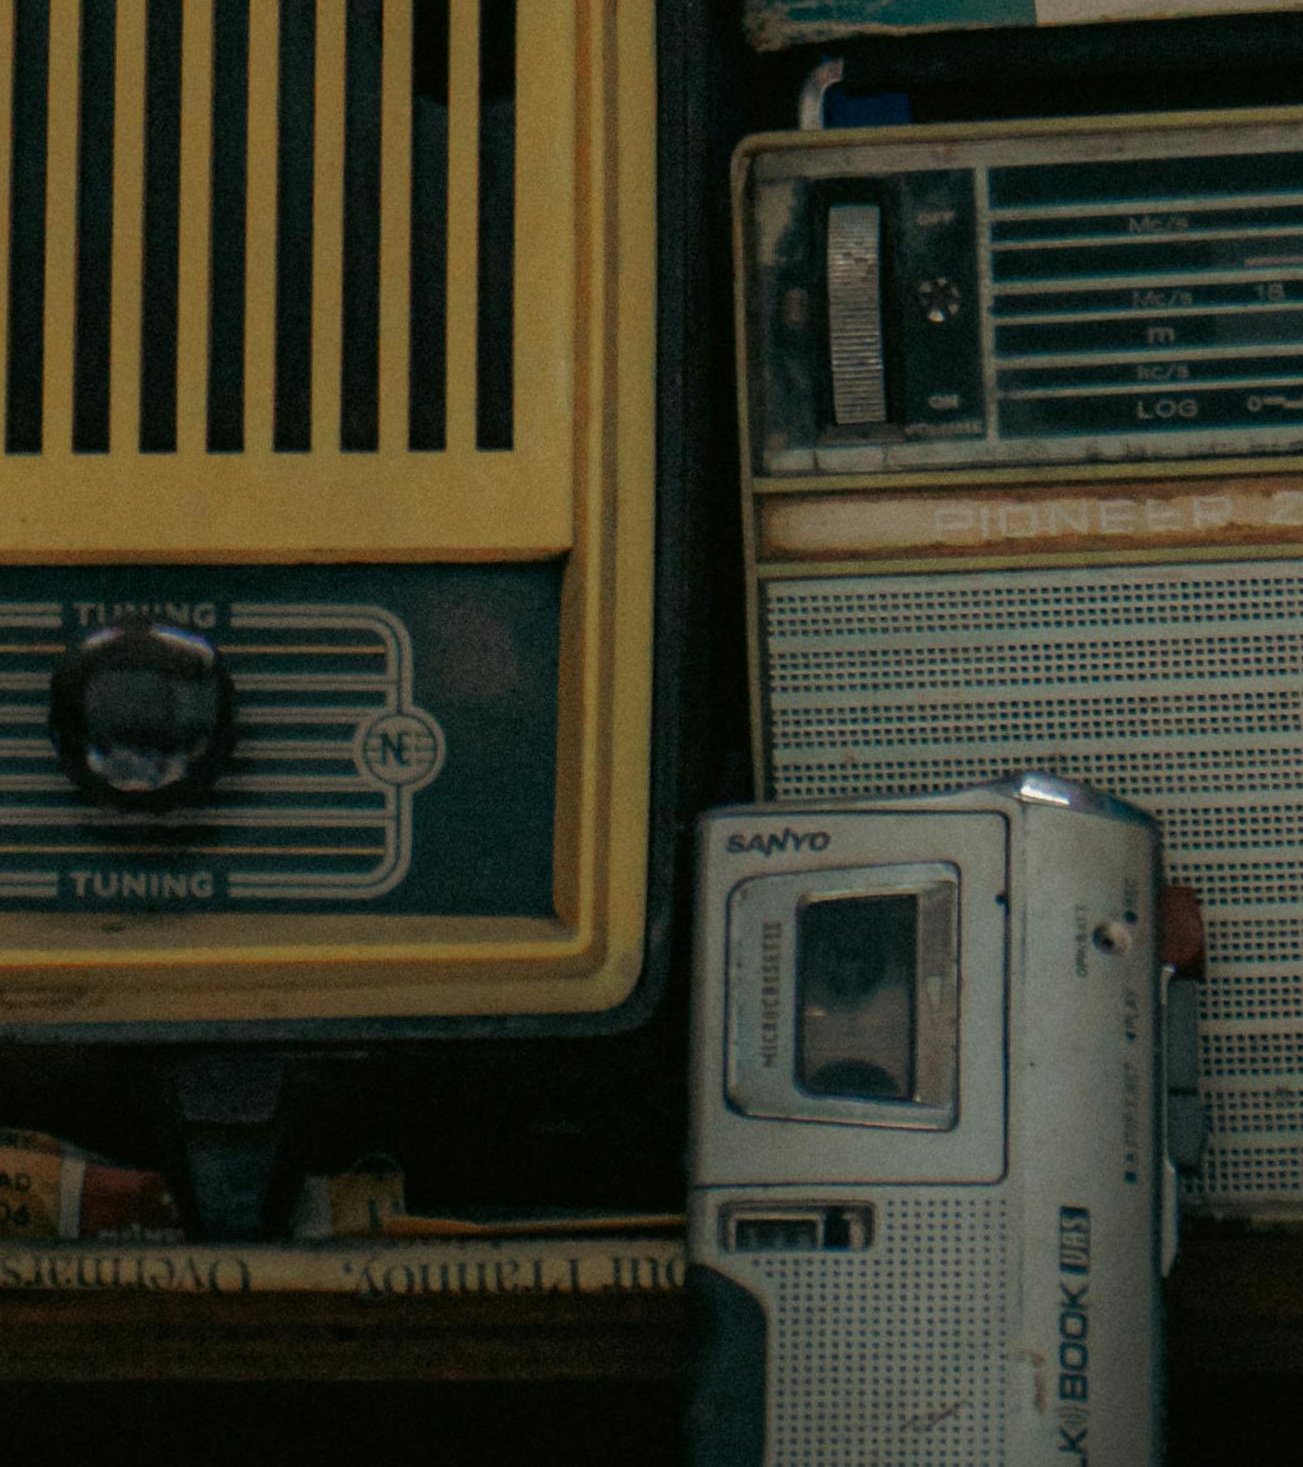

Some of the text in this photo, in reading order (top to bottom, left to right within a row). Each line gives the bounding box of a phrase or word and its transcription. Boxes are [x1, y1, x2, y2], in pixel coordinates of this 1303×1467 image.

[1137, 399, 1199, 420] LOG
[935, 494, 1235, 543] PIONEER
[724, 827, 831, 857] SANYO
[74, 872, 214, 899] TUNING
[1056, 1281, 1086, 1403] BOOK
